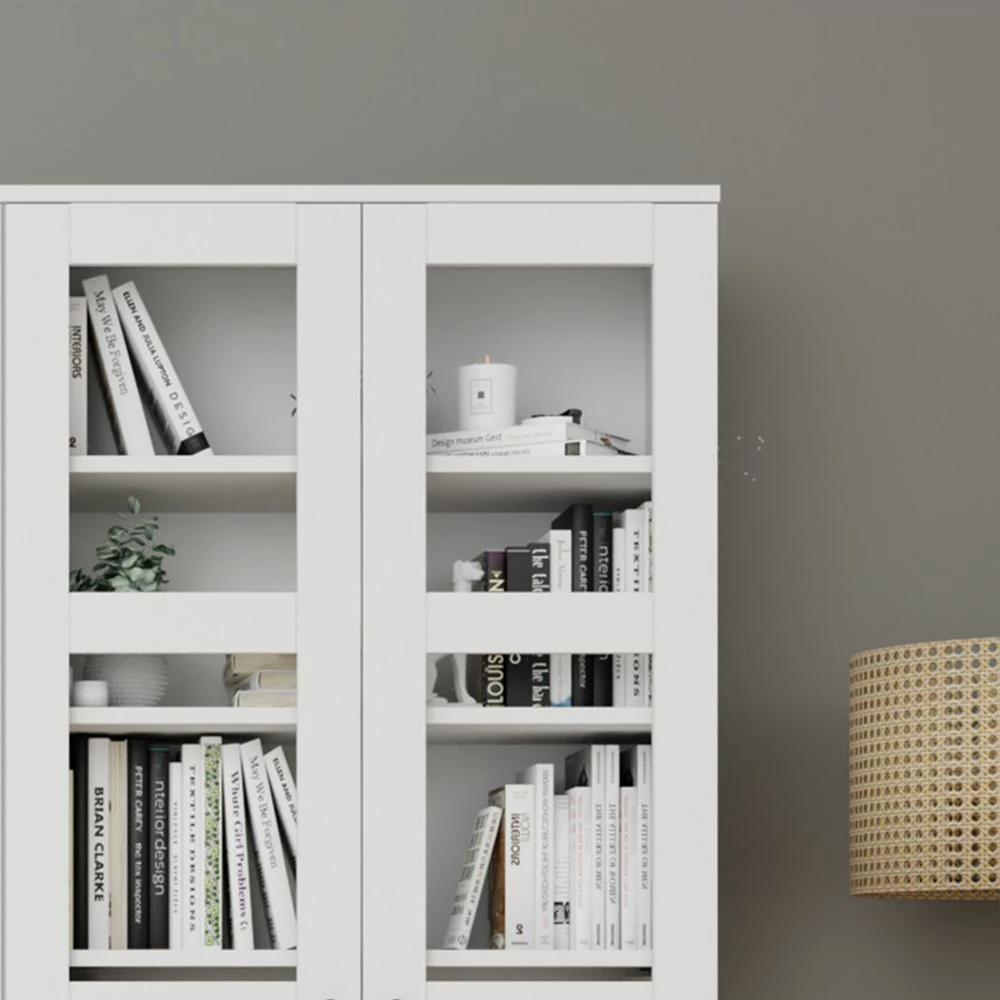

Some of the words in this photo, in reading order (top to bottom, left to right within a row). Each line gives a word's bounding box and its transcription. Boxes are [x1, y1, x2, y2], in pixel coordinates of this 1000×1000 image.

[101, 314, 113, 333] We
[106, 333, 117, 349] Be
[123, 291, 137, 313] ELLEN
[134, 314, 146, 333] AND
[143, 333, 157, 355] JULIA
[153, 355, 171, 387] LUPTON
[72, 325, 82, 379] INTERIORS
[110, 350, 128, 395] Forgiven
[69, 437, 77, 448] 2
[487, 654, 504, 704] LOUIS
[134, 765, 143, 797] PETER
[256, 782, 267, 801] We
[272, 757, 284, 781] ELLEN
[281, 781, 292, 800] AND
[94, 787, 104, 837] BRIAN
[134, 799, 143, 832] CAREY
[259, 803, 269, 817] Be
[134, 842, 143, 859] the
[234, 820, 244, 849] Girl
[263, 818, 277, 869] Forgiven
[94, 842, 104, 902] CLARKE
[152, 837, 166, 896] design
[236, 852, 249, 918] Problems
[133, 878, 143, 924] inspector
